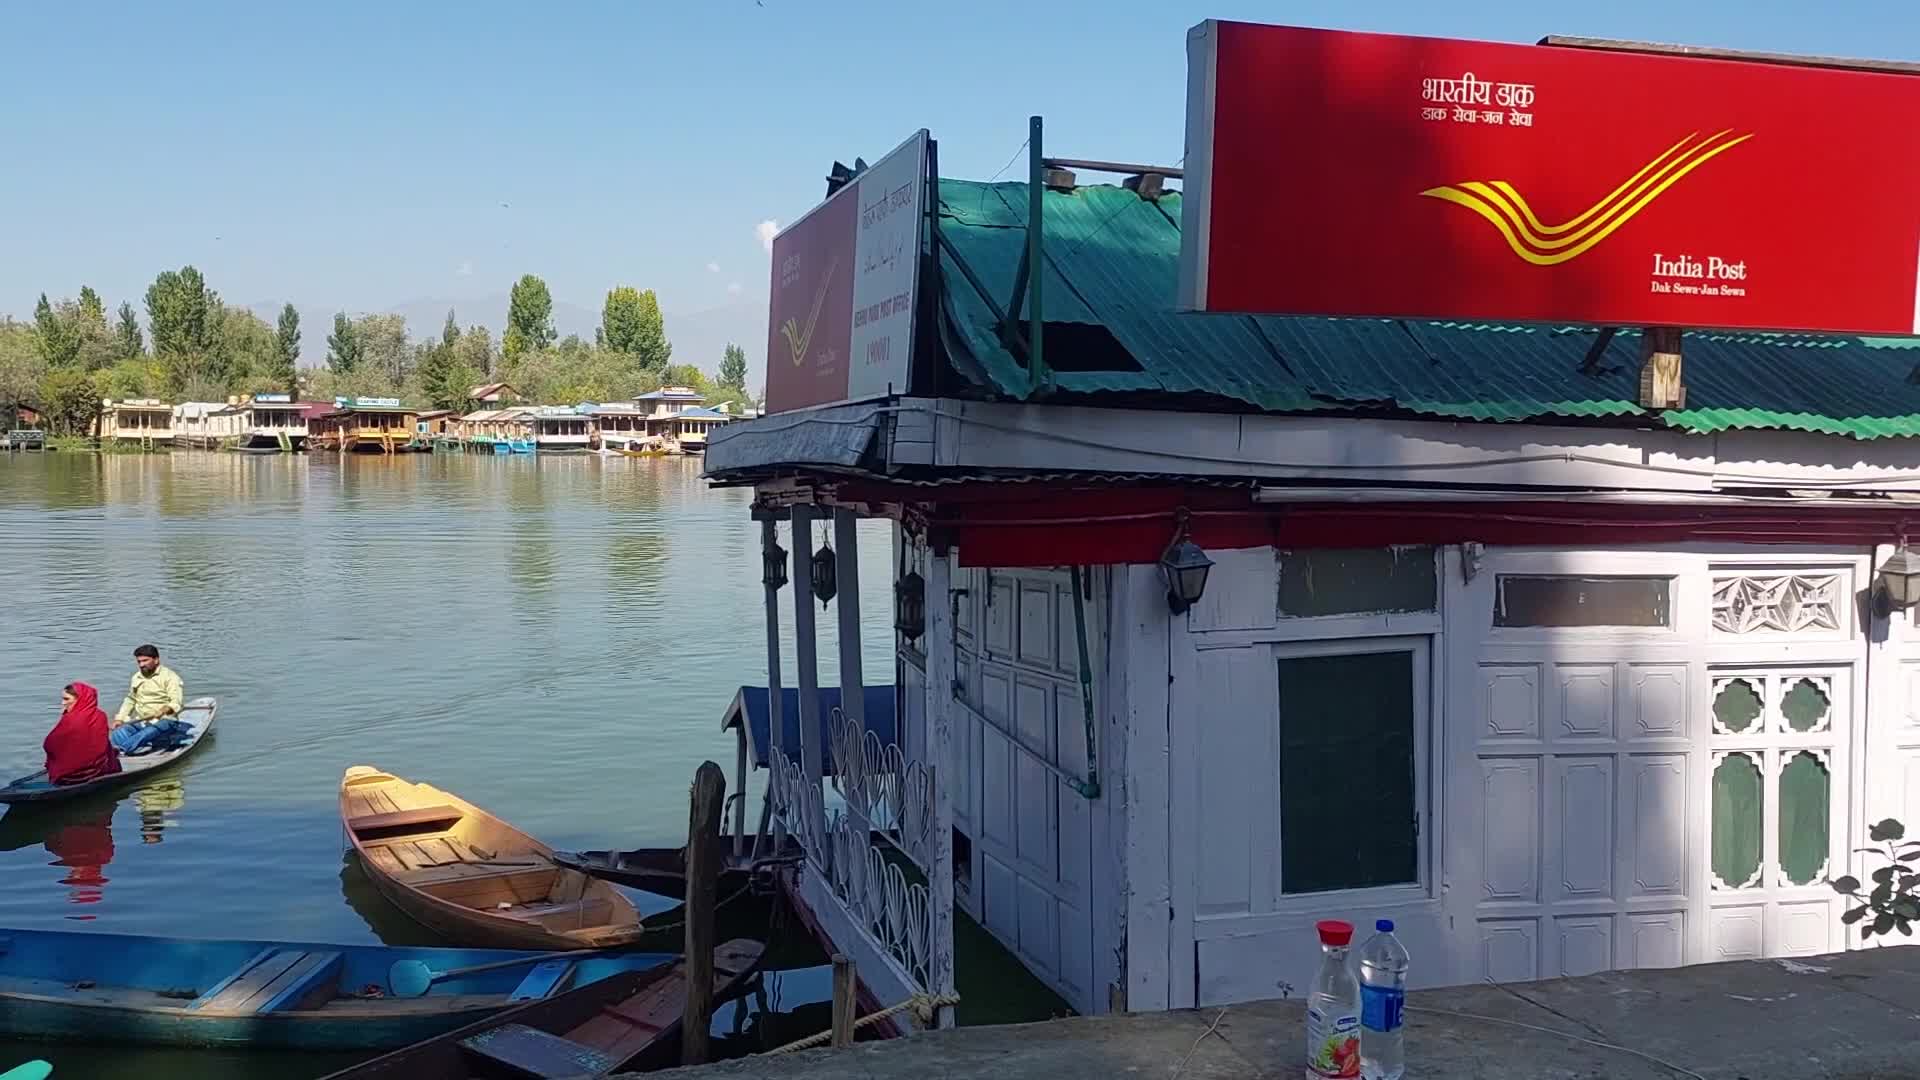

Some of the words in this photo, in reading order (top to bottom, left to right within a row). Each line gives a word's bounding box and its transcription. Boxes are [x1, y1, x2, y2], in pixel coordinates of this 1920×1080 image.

[1422, 72, 1493, 105] भारतीय
[1495, 82, 1535, 107] डाक
[1421, 107, 1448, 121] डाक
[1452, 105, 1504, 125] सेवा-जन
[1508, 108, 1533, 127] सेवा
[1652, 253, 1703, 278] India
[1706, 256, 1747, 280] Post
[1651, 281, 1672, 293] Dak
[1673, 282, 1719, 295] Sewa-Jan
[1720, 284, 1745, 297] Sewa
